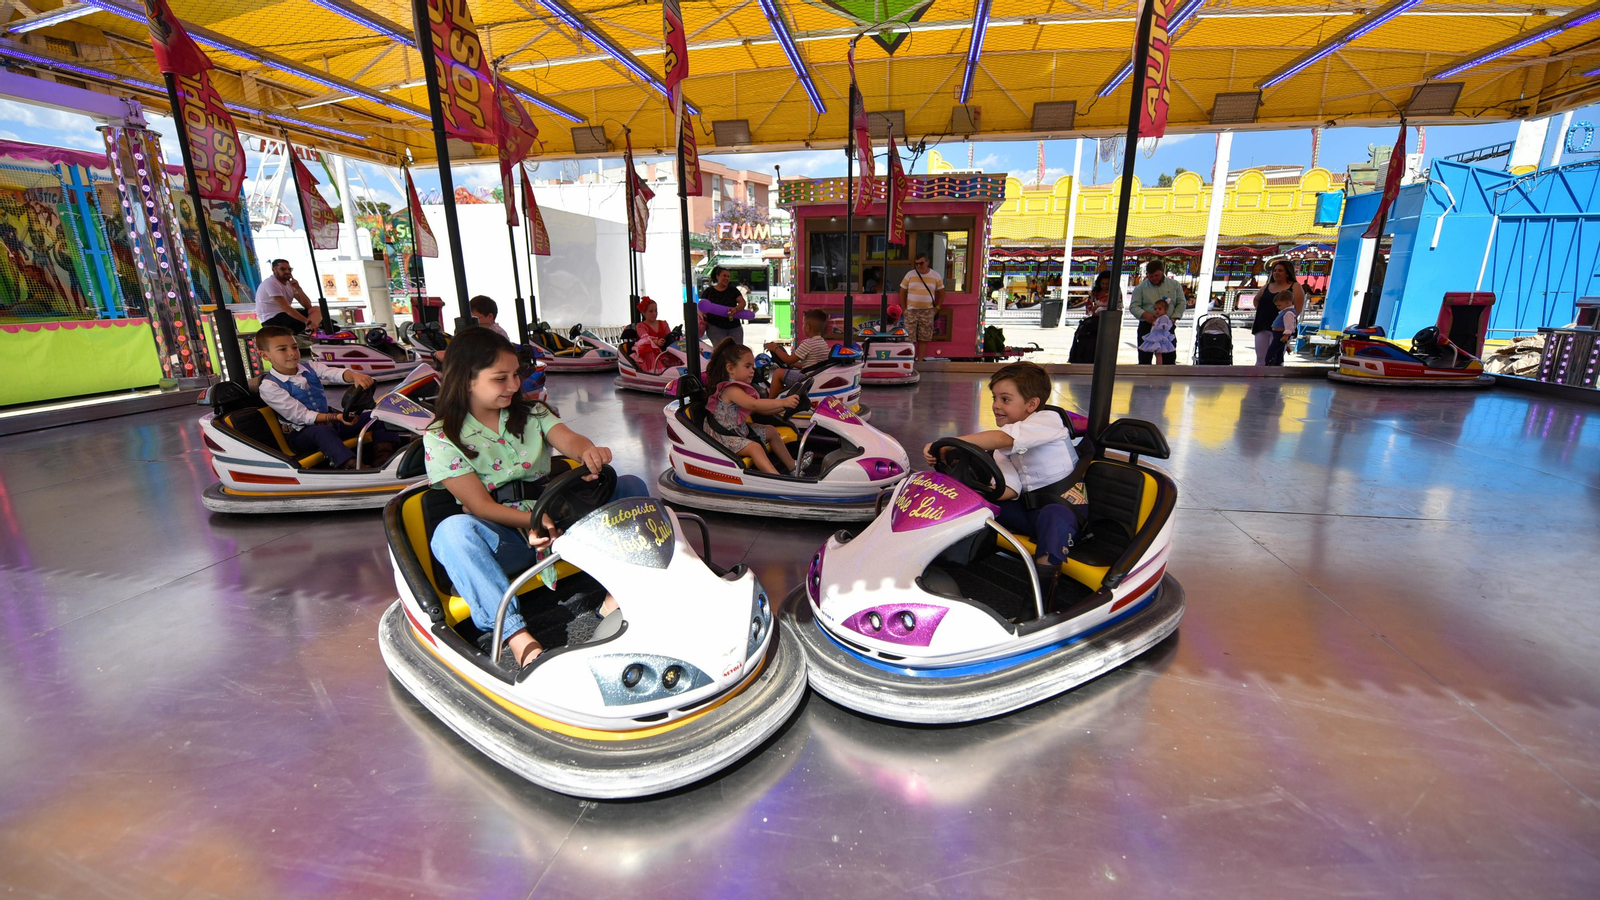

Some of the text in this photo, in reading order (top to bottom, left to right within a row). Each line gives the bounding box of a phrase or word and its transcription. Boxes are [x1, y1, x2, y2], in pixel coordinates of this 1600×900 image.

[324, 353, 333, 361] 10
[881, 351, 886, 359] 5
[911, 474, 958, 499] Autopista
[600, 503, 657, 528] Autopista
[909, 496, 946, 520] Luis
[645, 518, 673, 547] Luis
